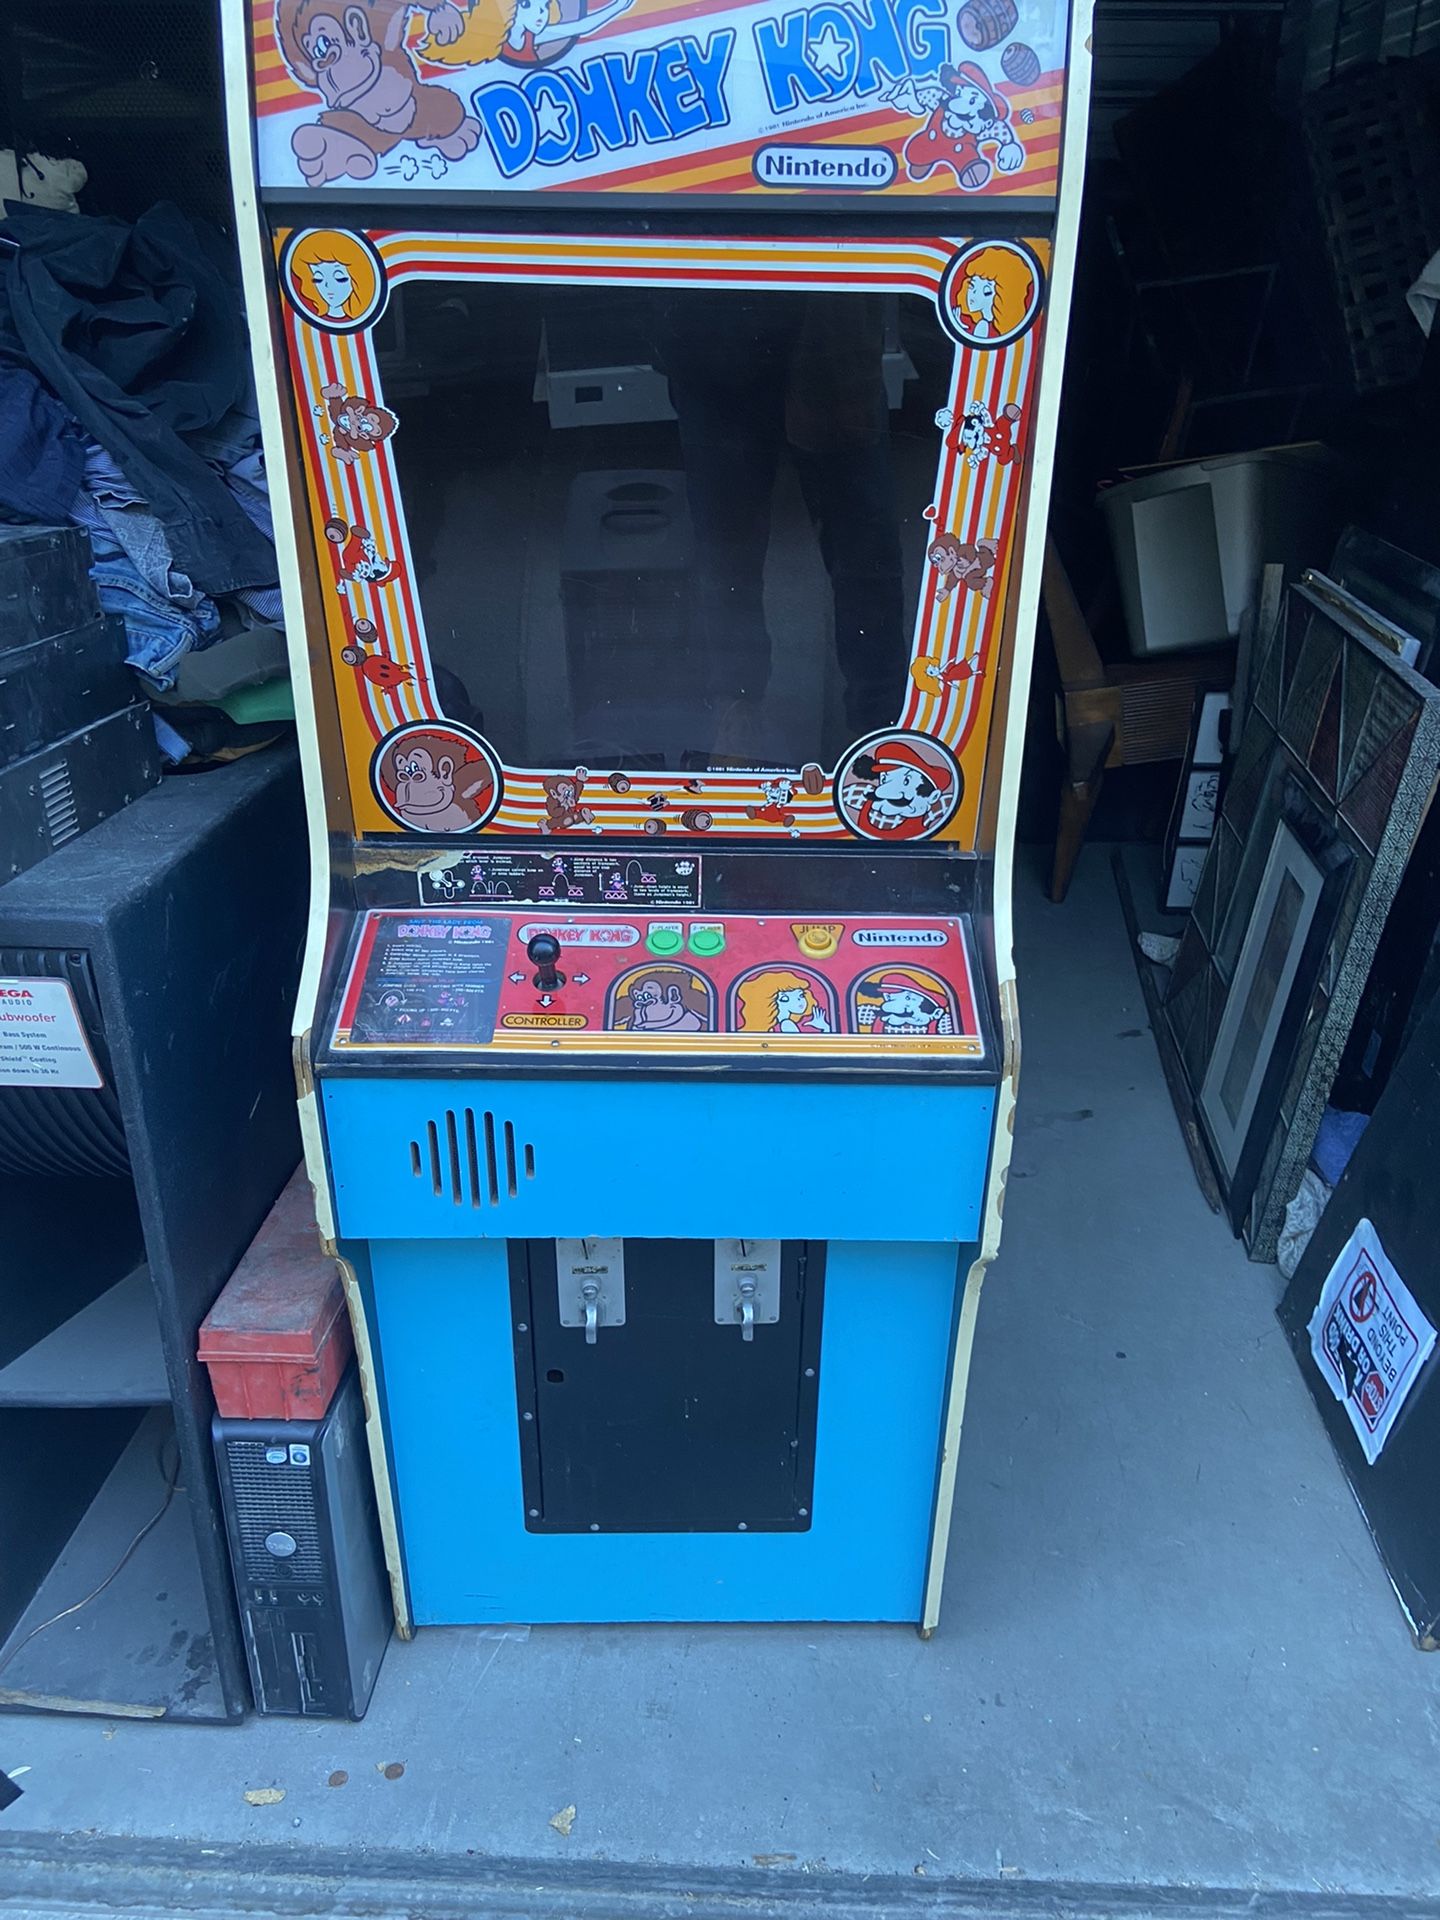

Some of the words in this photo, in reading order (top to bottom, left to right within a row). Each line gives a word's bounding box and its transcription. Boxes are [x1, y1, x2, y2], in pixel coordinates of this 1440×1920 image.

[472, 28, 735, 178] DONKEY
[753, 0, 947, 114] KONG
[781, 114, 815, 128] Nintendo
[824, 104, 855, 117] America
[765, 155, 887, 178] Nintendo
[397, 924, 452, 938] DONKEY
[452, 925, 492, 939] KONG
[589, 928, 632, 943] KONG
[857, 932, 944, 943] Nintendo
[505, 1016, 582, 1026] CONTROLLER
[1382, 1306, 1408, 1347] POINT
[1379, 1324, 1398, 1358] THIS
[1367, 1328, 1397, 1383] BEYOND
